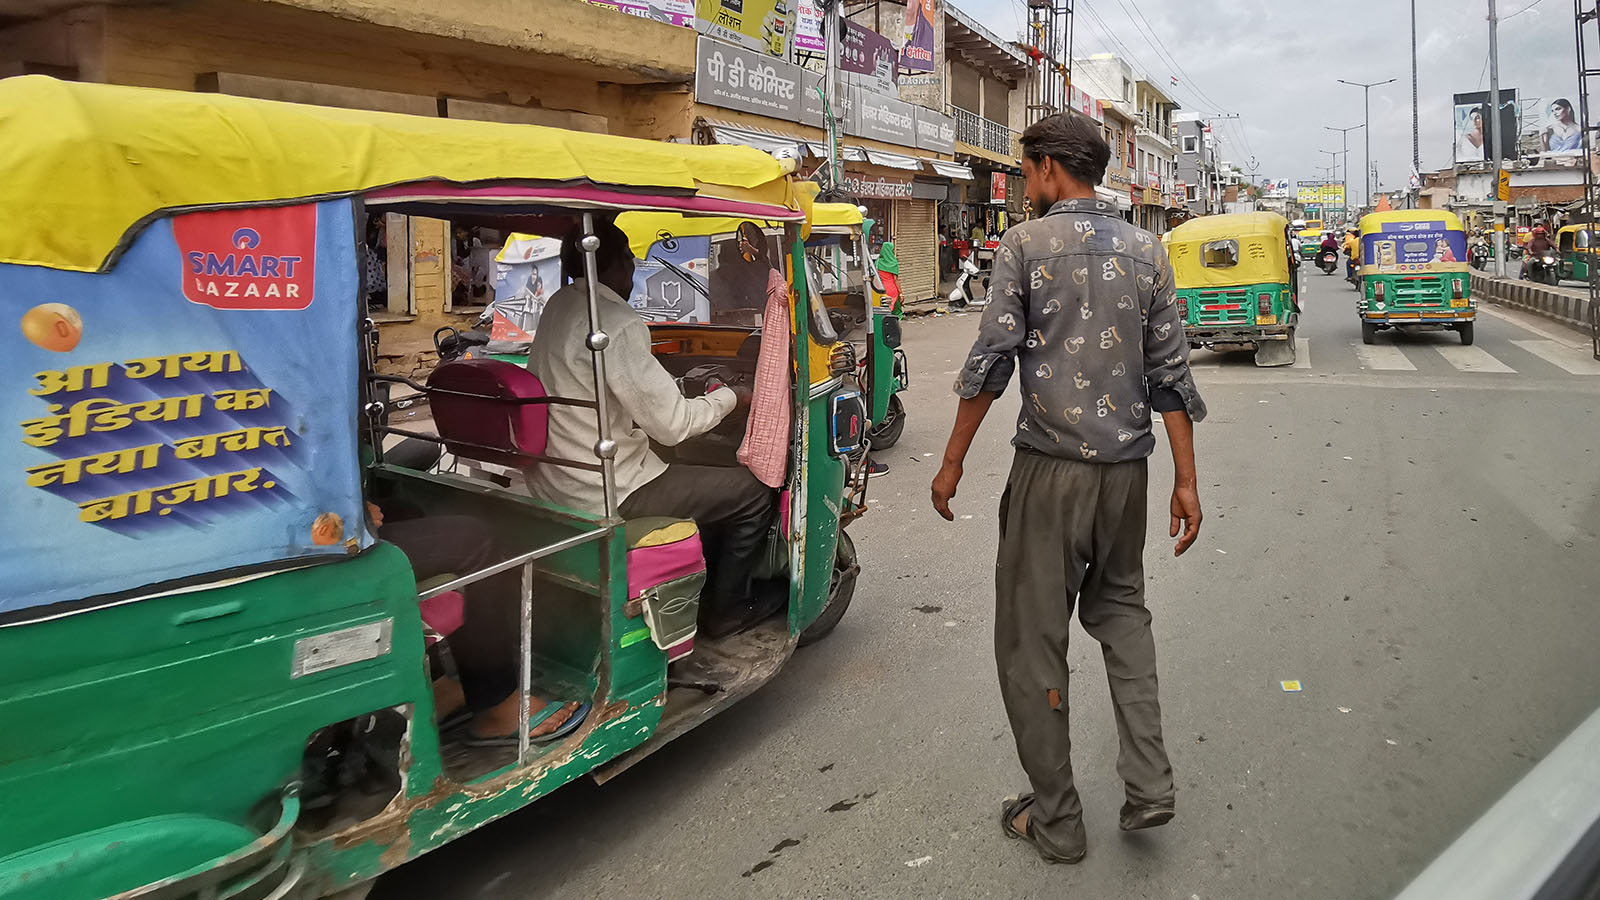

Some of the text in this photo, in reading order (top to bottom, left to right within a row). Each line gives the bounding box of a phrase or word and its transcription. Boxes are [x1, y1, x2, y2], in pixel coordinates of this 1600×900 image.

[706, 51, 725, 82] पी
[728, 57, 745, 88] डी
[748, 63, 796, 100] कैमिस्ट
[188, 251, 301, 279] SMART
[27, 350, 242, 397] आ गया
[19, 388, 273, 447] इंडिया का
[25, 426, 292, 488] नया बचत
